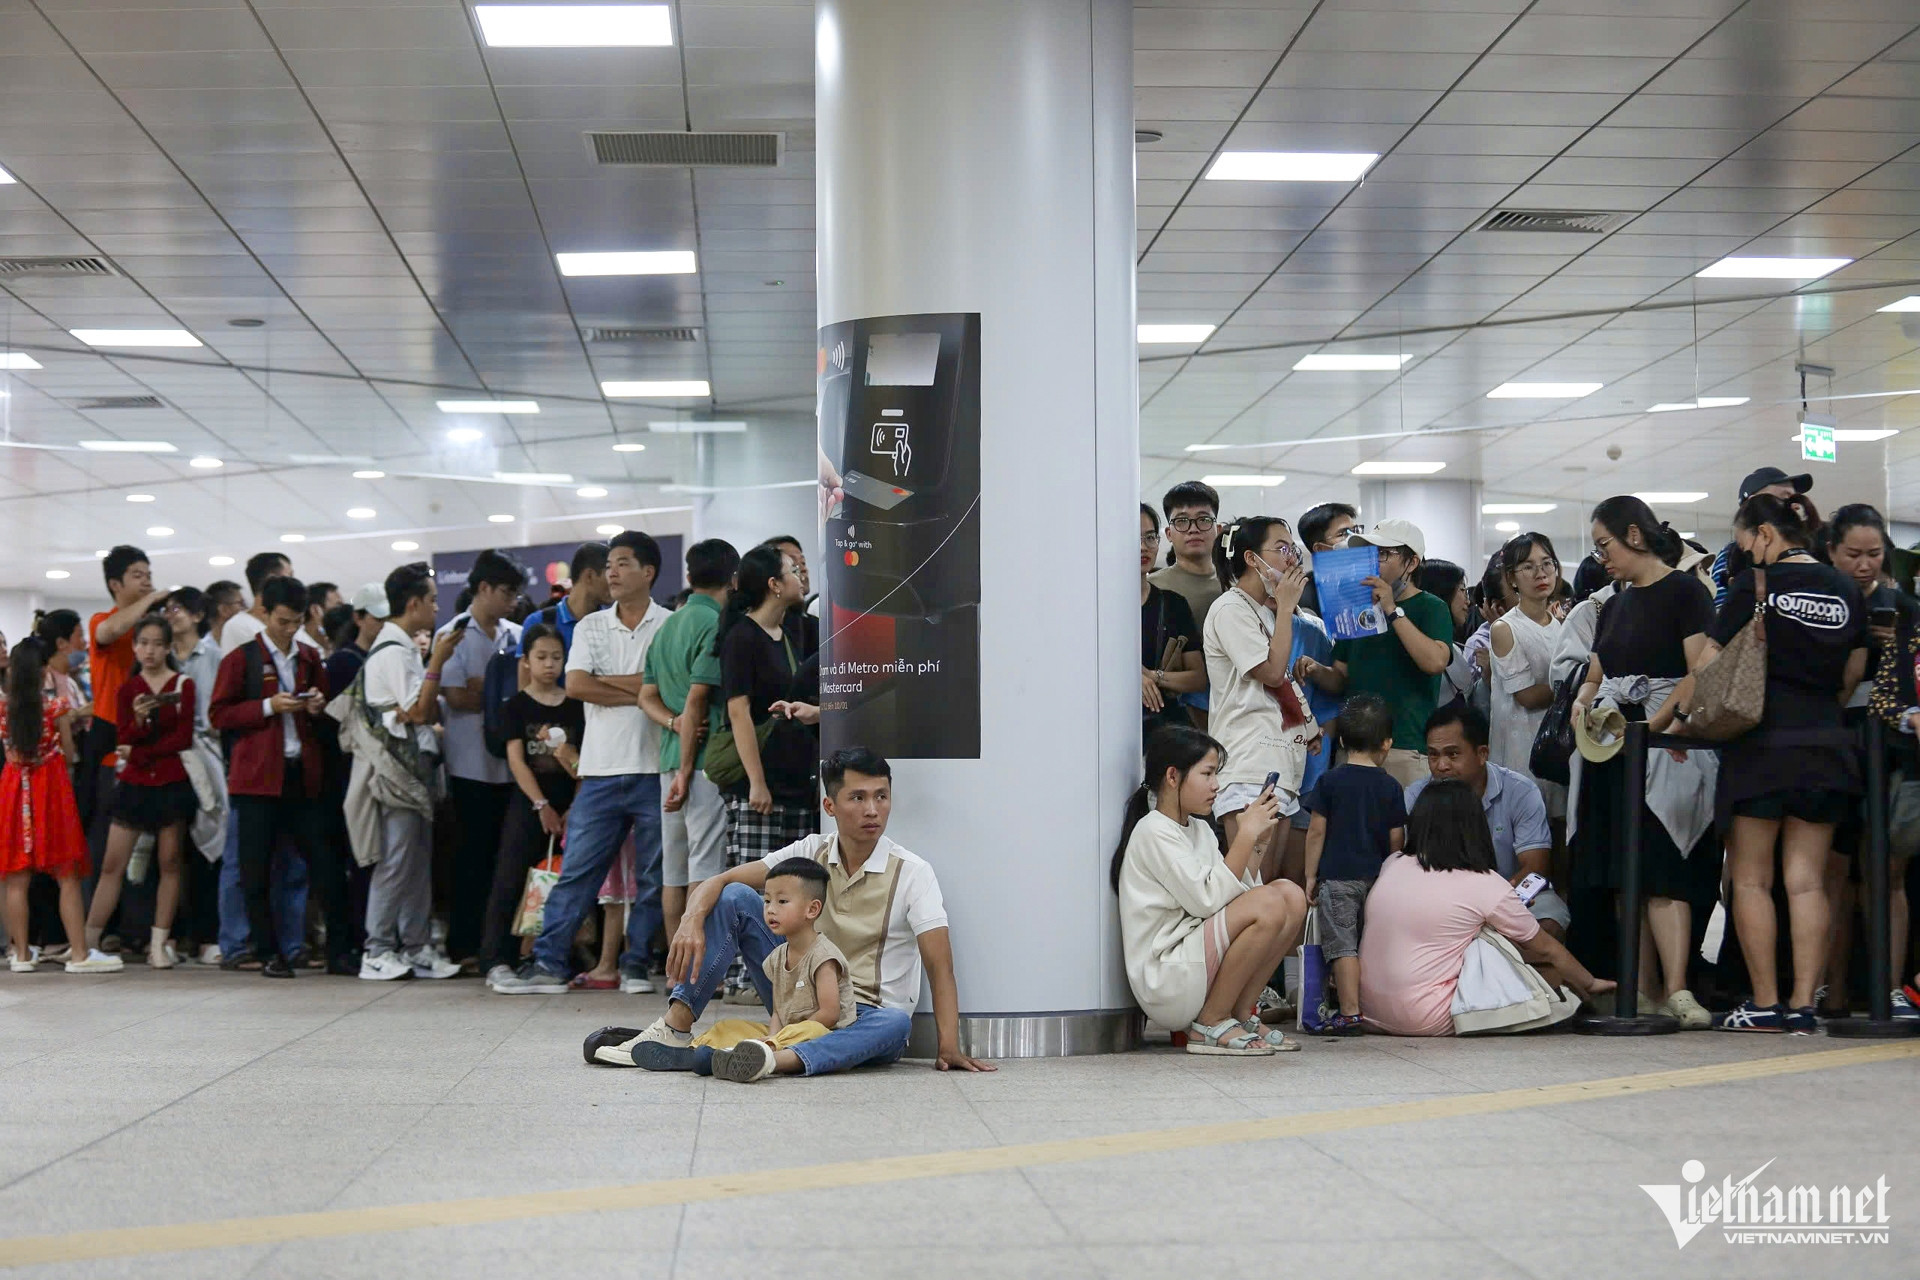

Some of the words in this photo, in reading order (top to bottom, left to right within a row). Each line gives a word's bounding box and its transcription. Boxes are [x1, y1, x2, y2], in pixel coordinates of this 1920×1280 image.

[858, 540, 872, 549] with
[1776, 594, 1844, 622] OUTDOOR
[838, 661, 846, 674] đi
[847, 661, 879, 674] Metro
[882, 658, 914, 673] miễn
[918, 659, 940, 675] phí
[823, 679, 863, 694] Mastercard
